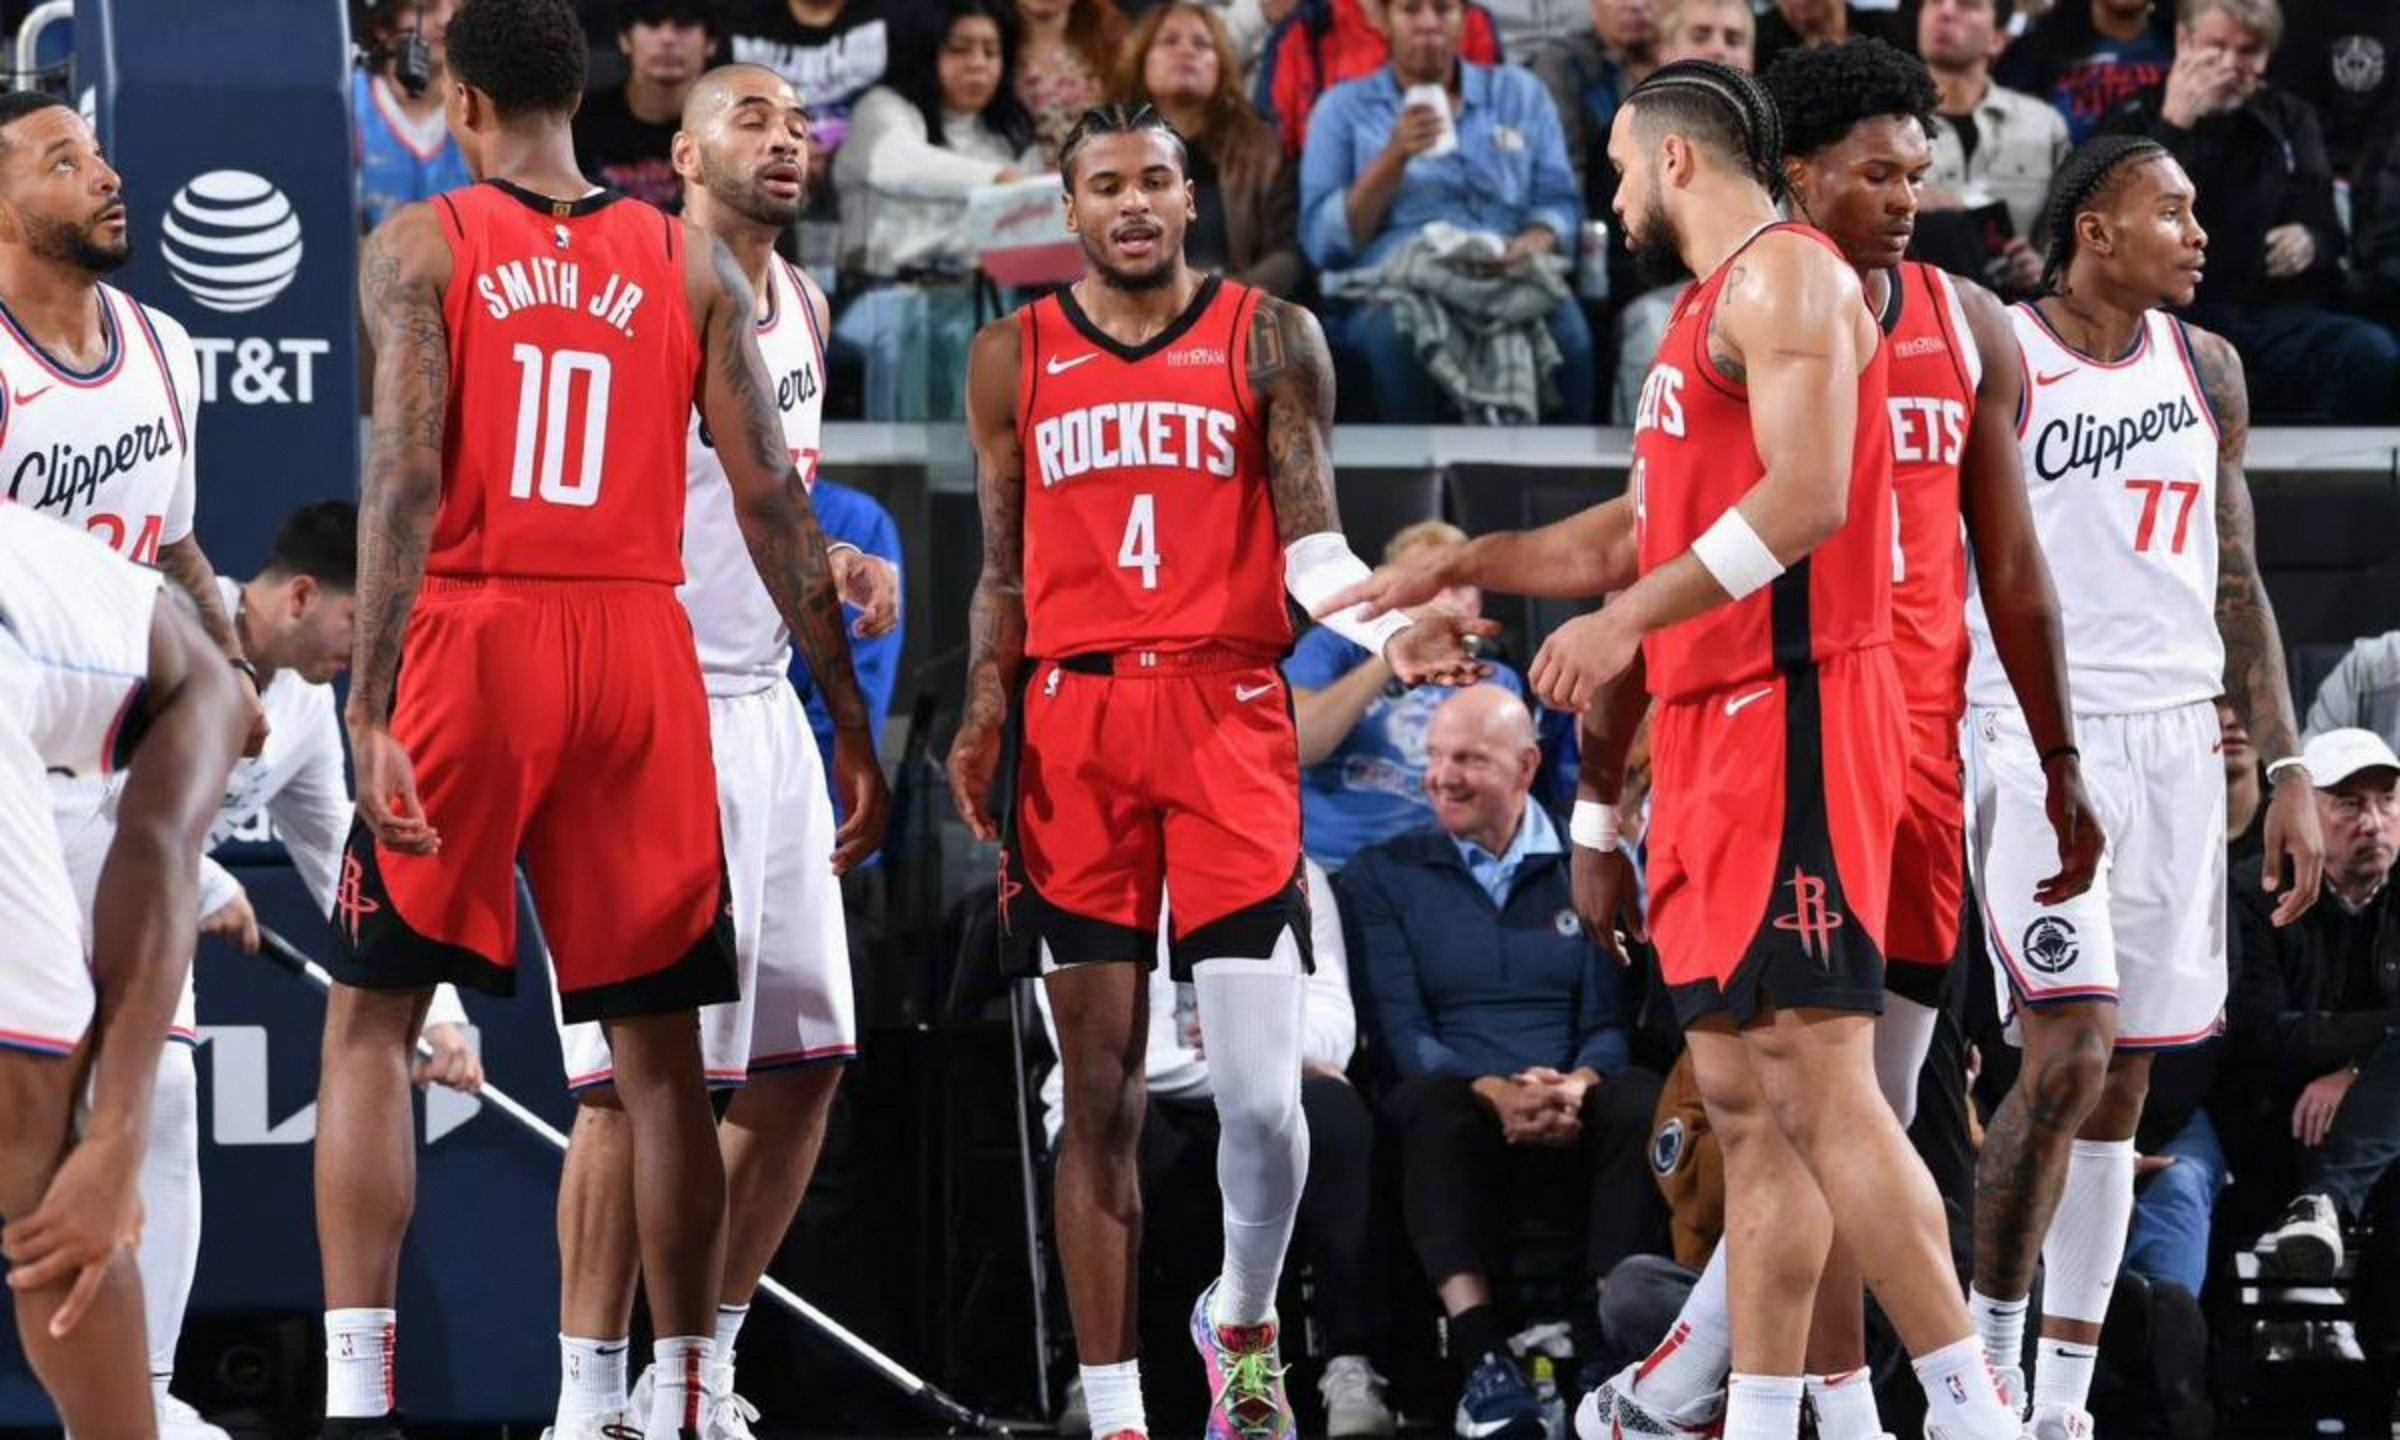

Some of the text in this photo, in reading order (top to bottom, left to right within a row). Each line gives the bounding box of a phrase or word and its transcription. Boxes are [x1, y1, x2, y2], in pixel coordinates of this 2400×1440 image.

[478, 257, 643, 338] SMITH JR.
[190, 337, 330, 405] T&T
[7, 416, 172, 517] Clippers
[510, 343, 612, 506] 10
[1035, 401, 1237, 488] ROCKETS
[1888, 397, 1965, 465] ETS
[2035, 395, 2198, 481] Clippers
[1118, 493, 1161, 589] 4
[2125, 480, 2200, 554] 77
